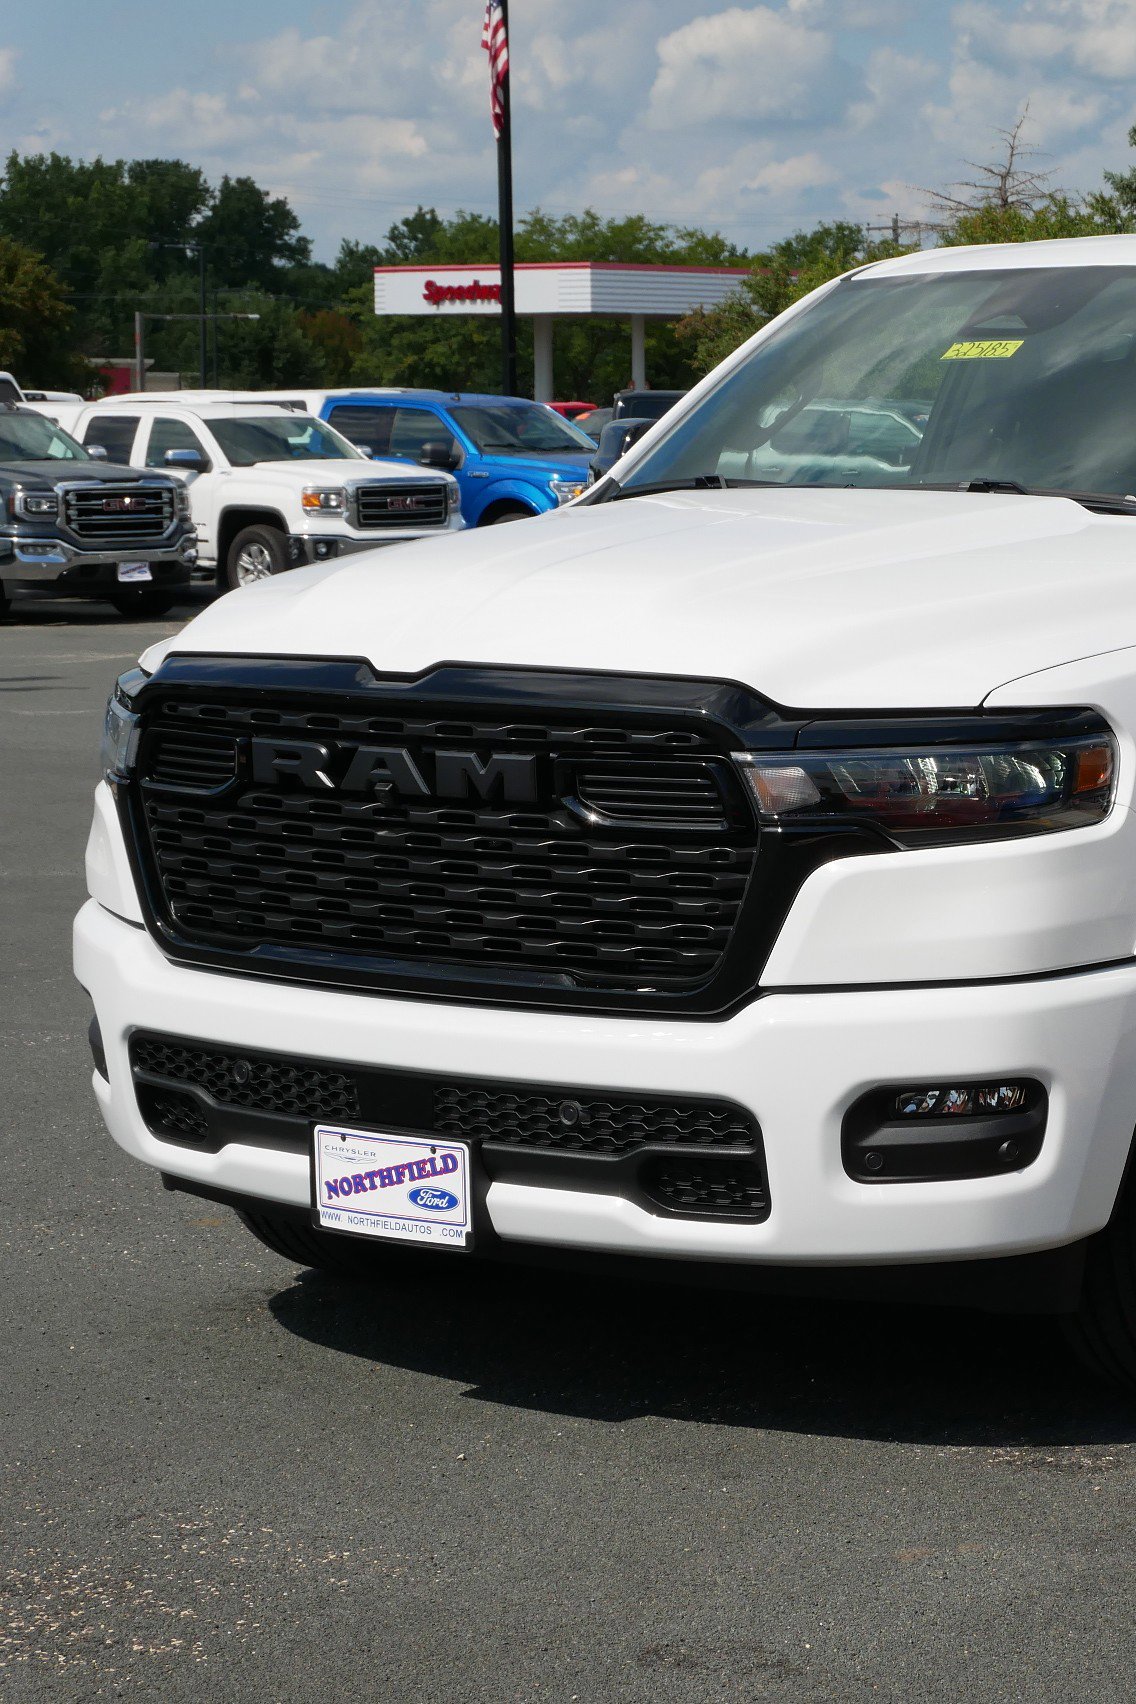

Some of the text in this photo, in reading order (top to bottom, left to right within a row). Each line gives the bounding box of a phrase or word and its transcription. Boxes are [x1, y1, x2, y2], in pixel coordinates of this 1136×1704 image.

[102, 498, 147, 511] GMC
[251, 737, 537, 801] RAM
[324, 1144, 377, 1158] CHRYSLER
[324, 1153, 459, 1200] NORTHFIELD
[416, 1188, 450, 1208] Ford
[347, 1215, 432, 1235] NORTHFIELDAUTOS
